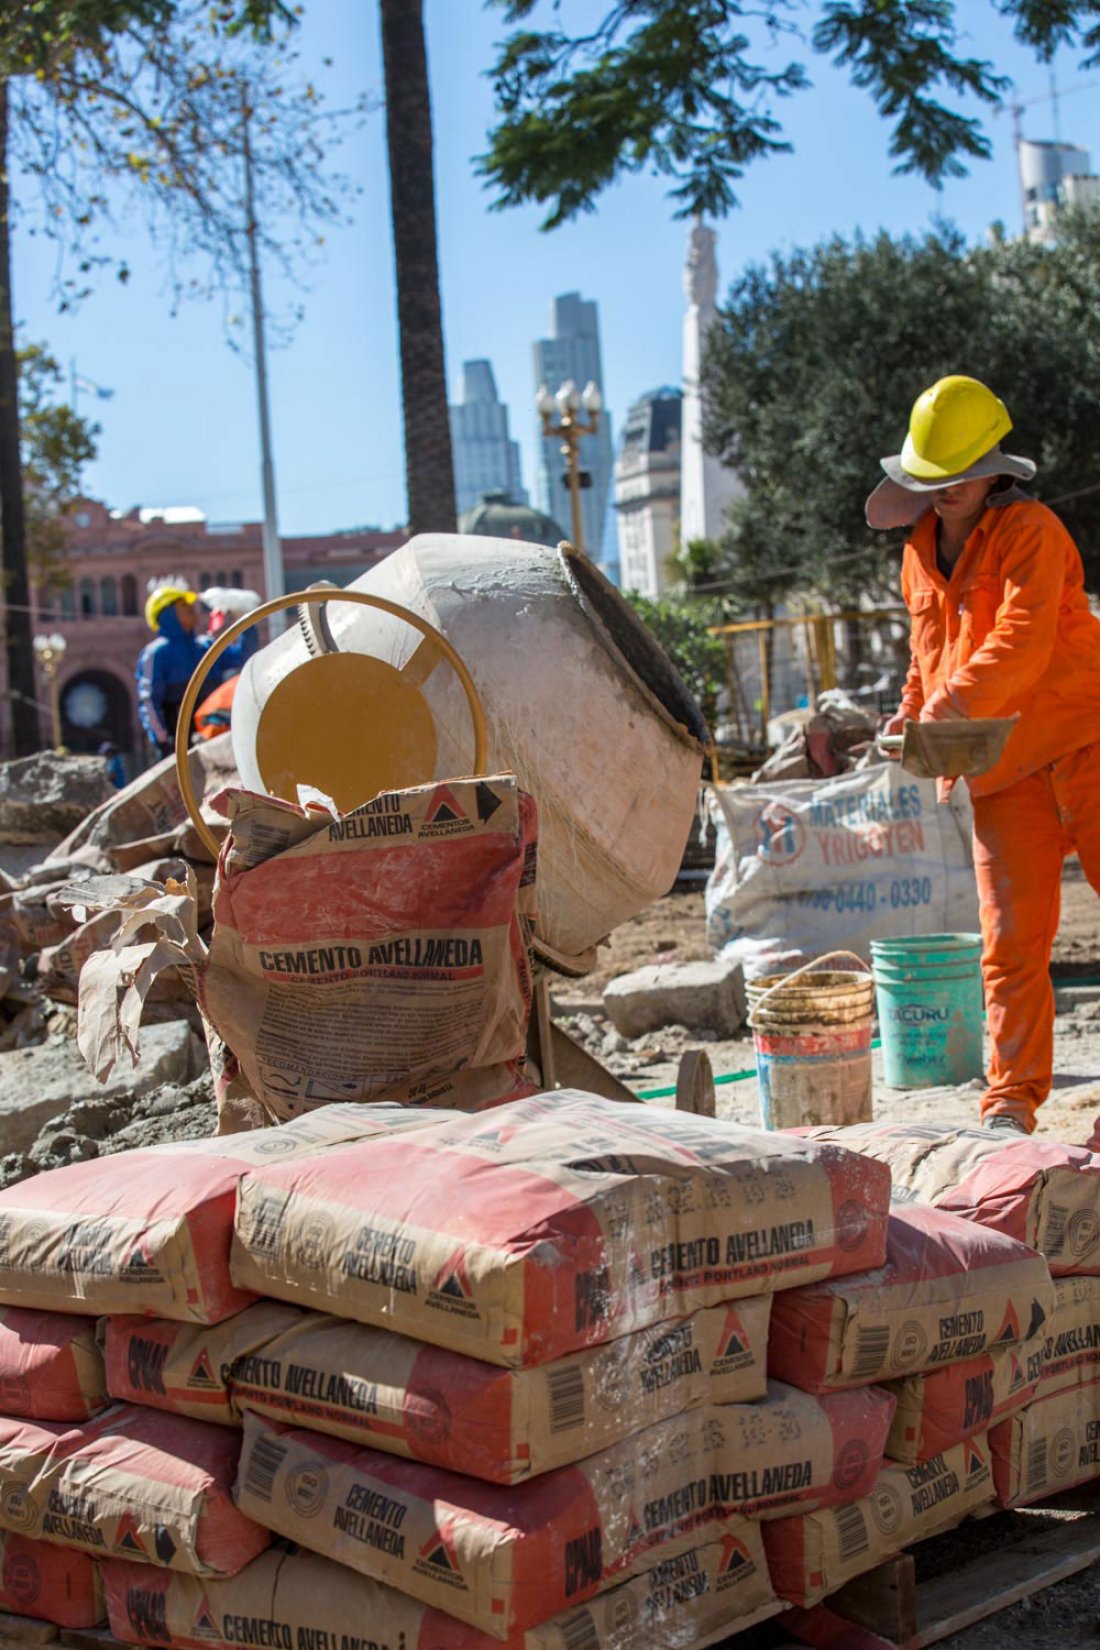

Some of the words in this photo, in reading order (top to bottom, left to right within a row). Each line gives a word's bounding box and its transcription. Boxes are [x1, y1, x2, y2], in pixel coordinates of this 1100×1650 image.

[329, 814, 413, 842] AVELLANEDA
[418, 825, 475, 839] AVELLANEDA
[421, 818, 471, 831] CEMENTOS
[818, 820, 926, 866] YRIGOYEN
[890, 877, 932, 909] 0330
[259, 945, 362, 975] CEMENTO
[726, 1219, 815, 1265] AVELLANEDA
[704, 1264, 768, 1282] PORTLAND
[285, 1363, 377, 1415] AVELLANEDA
[346, 1484, 407, 1529] CEMENTO
[644, 1479, 707, 1530] CEMENTO
[709, 1460, 813, 1502] AVELLANEDA
[334, 1506, 406, 1561] AVELLANEDA
